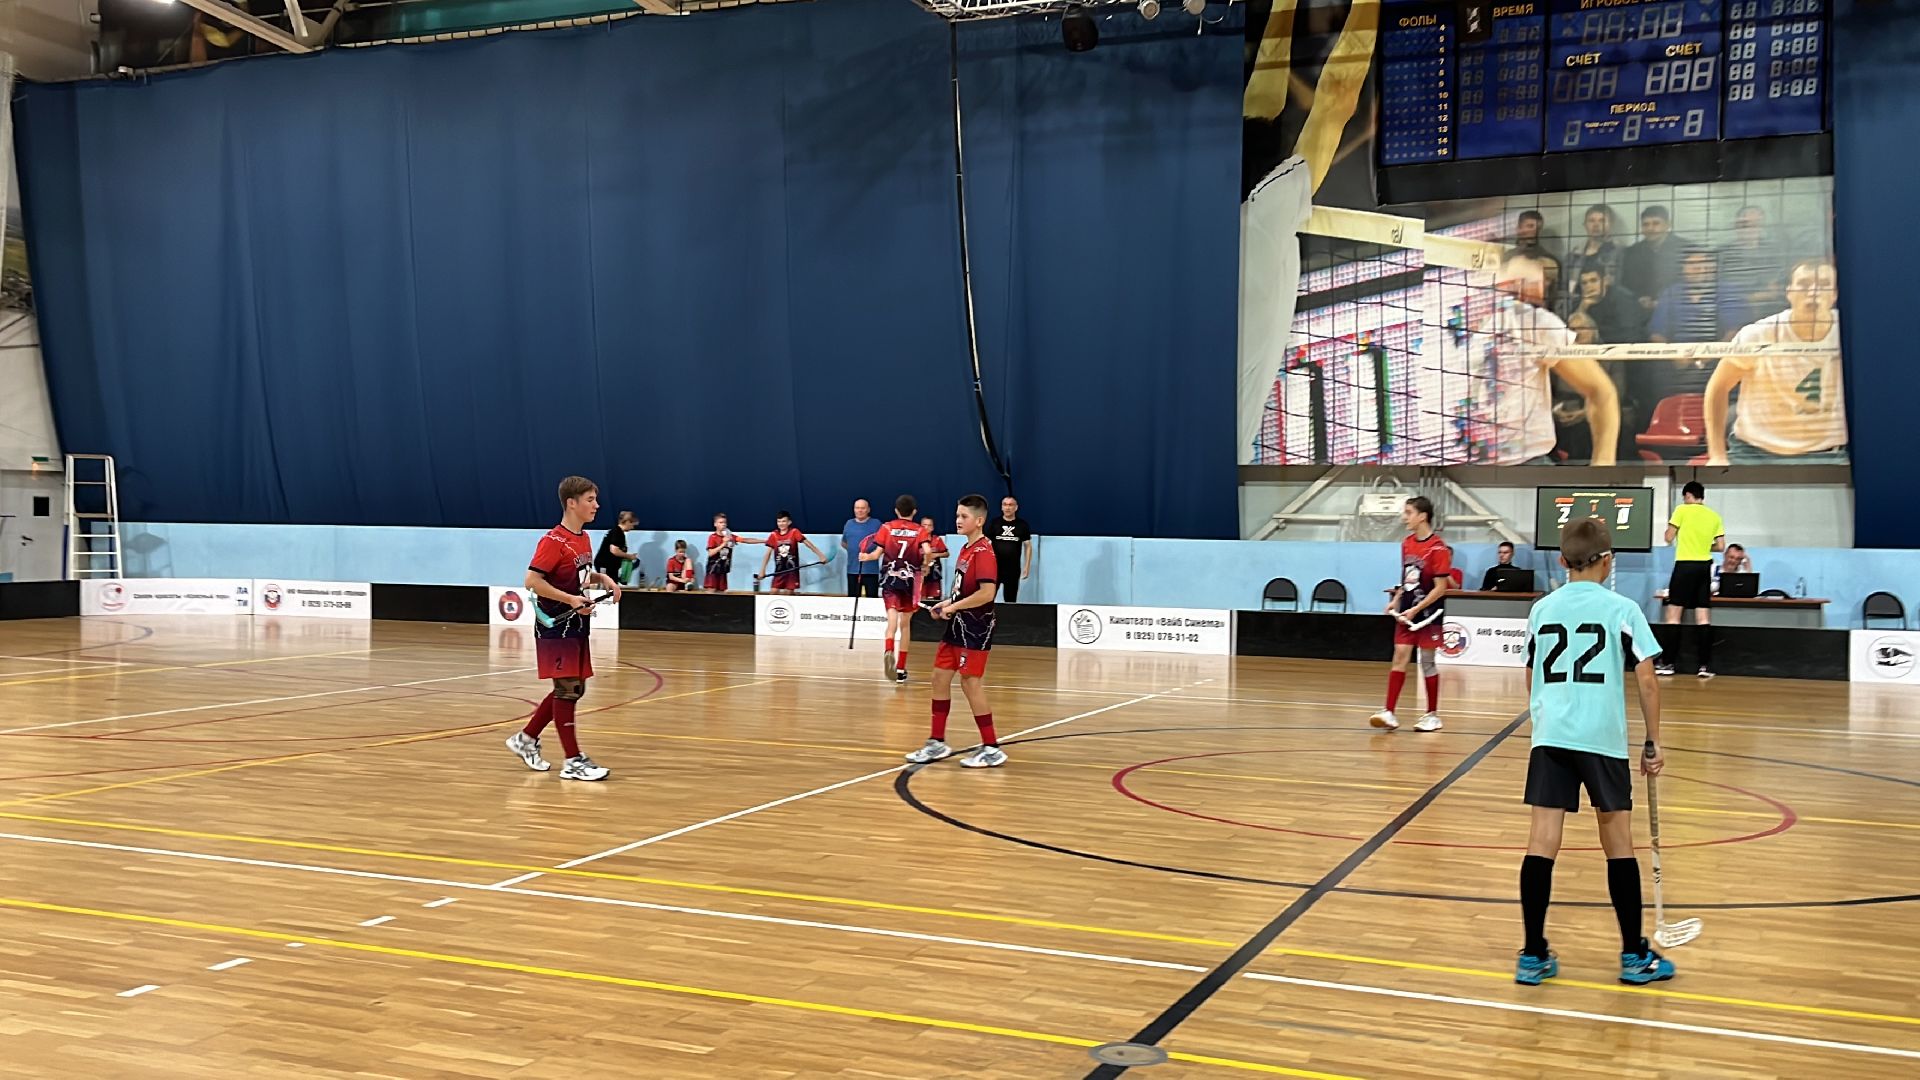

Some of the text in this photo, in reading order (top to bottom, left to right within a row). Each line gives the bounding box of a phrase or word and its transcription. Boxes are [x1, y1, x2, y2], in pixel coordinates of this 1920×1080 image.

[1493, 4, 1534, 17] ВРЕМЯ
[1399, 14, 1437, 27] ФОЛЫ
[1610, 102, 1656, 114] ПЕРИОД
[1438, 114, 1448, 122] 12
[1795, 368, 1821, 402] 4
[1558, 506, 1570, 523] 2
[897, 540, 908, 558] 7
[1109, 615, 1153, 626] Кинотеатр
[1133, 631, 1155, 641] (925)
[1477, 628, 1492, 636] АНО
[1538, 623, 1606, 684] 22
[555, 656, 563, 670] 2
